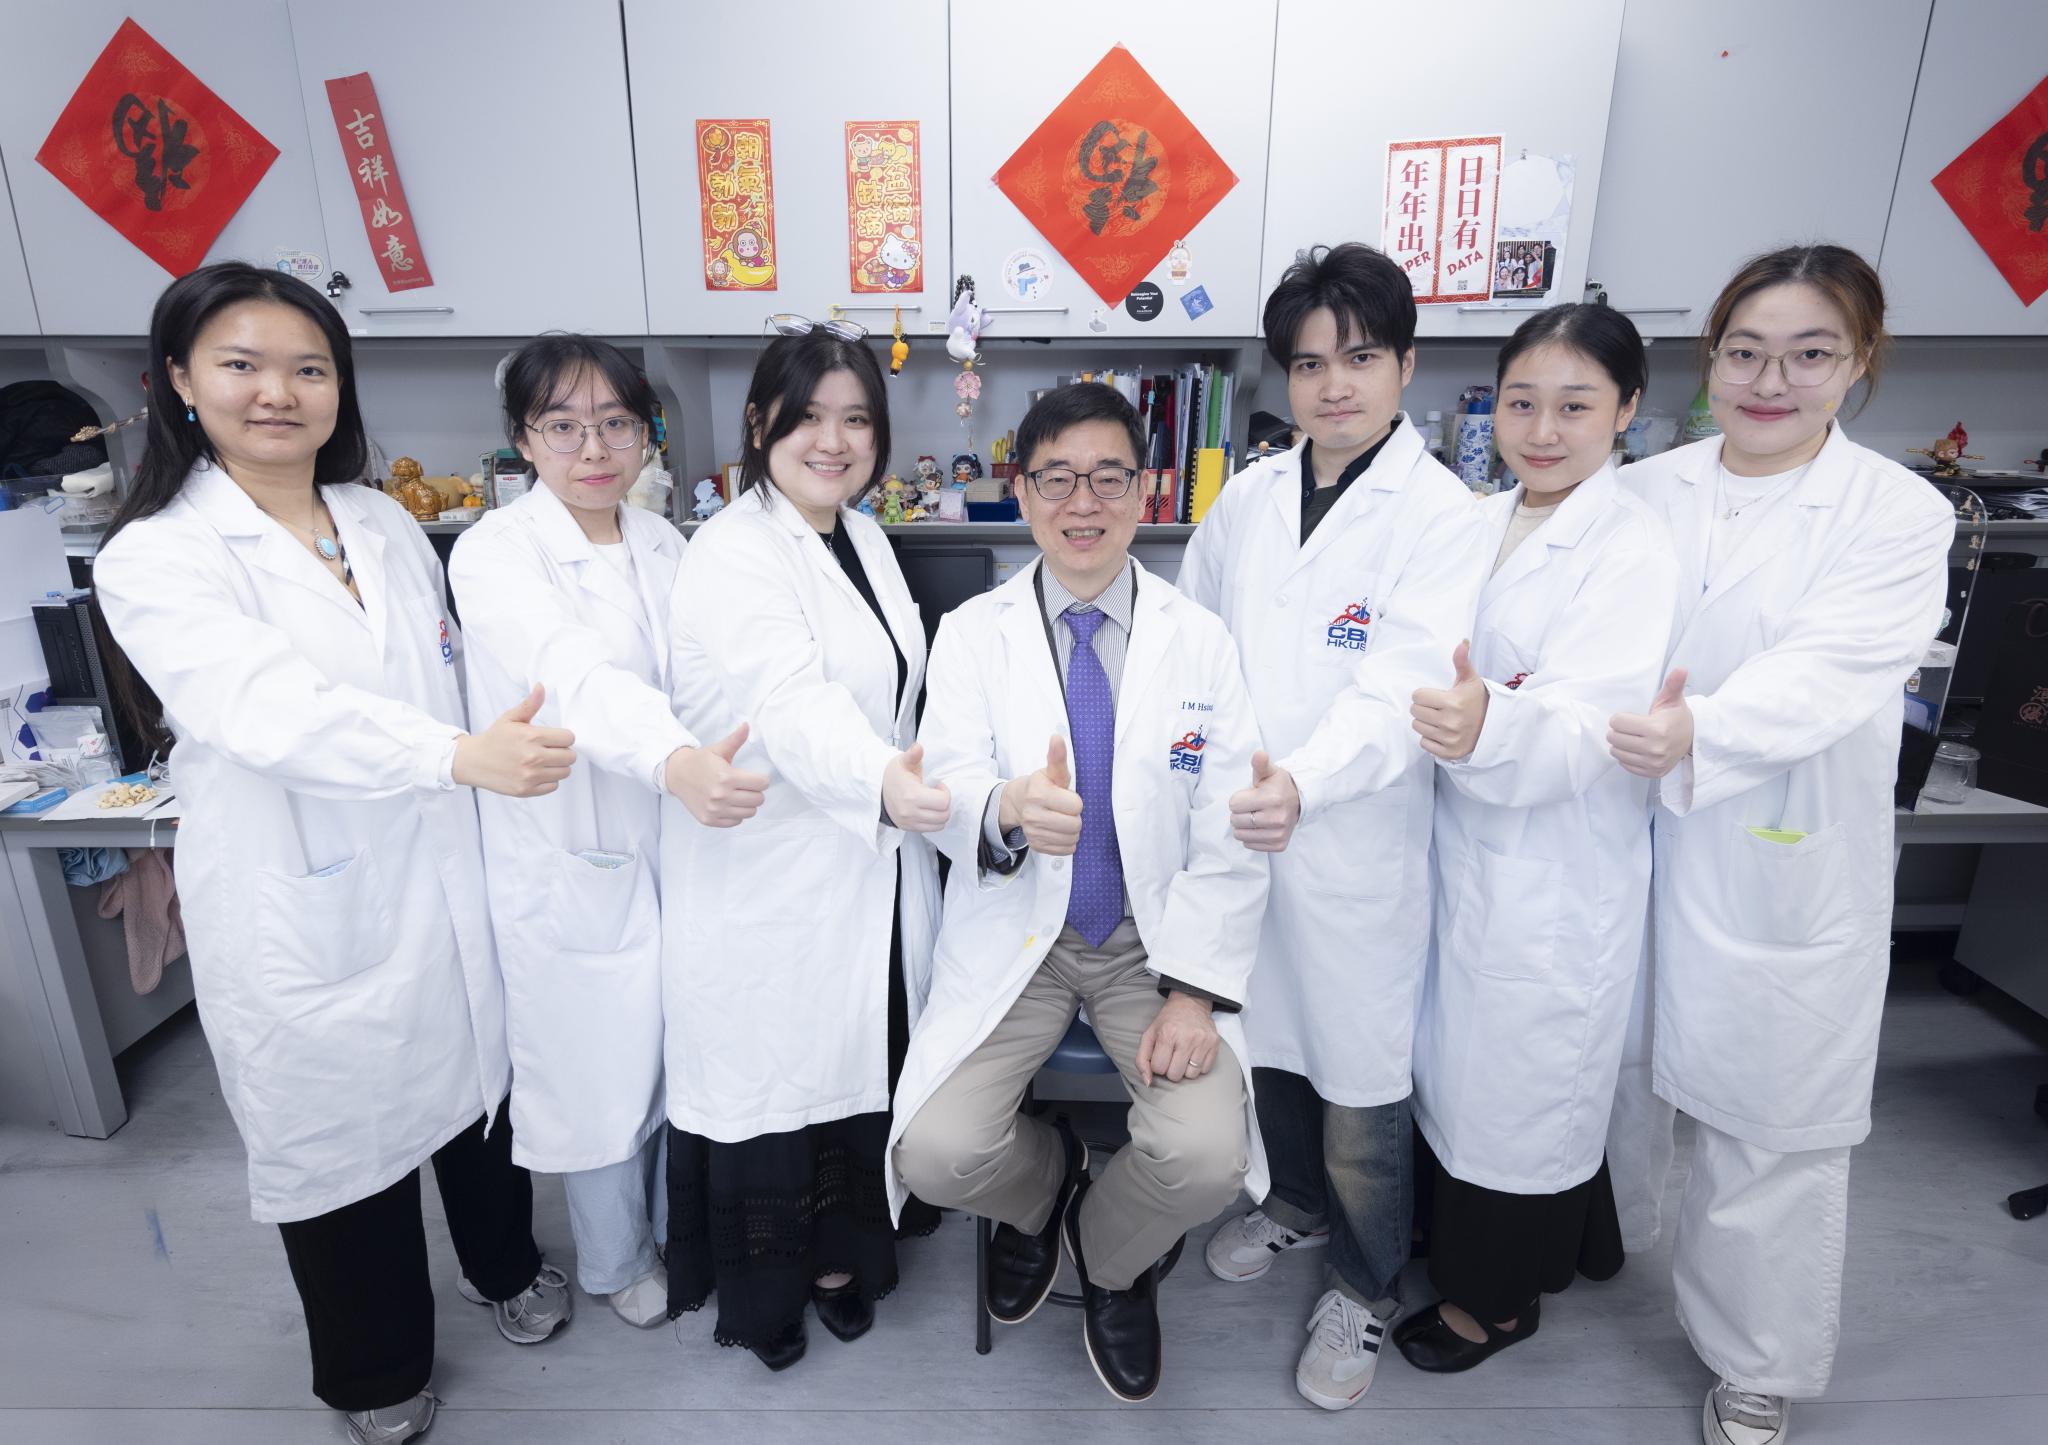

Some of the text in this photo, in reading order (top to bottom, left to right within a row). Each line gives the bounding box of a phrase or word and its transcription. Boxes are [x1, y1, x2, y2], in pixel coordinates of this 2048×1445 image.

[345, 109, 414, 273] 吉祥如意
[1452, 155, 1484, 251] 日日有
[1397, 159, 1429, 253] 年年出
[1397, 250, 1432, 273] PER
[1447, 249, 1484, 276] DATA
[1327, 638, 1367, 652] HKUS
[1187, 702, 1195, 711] M
